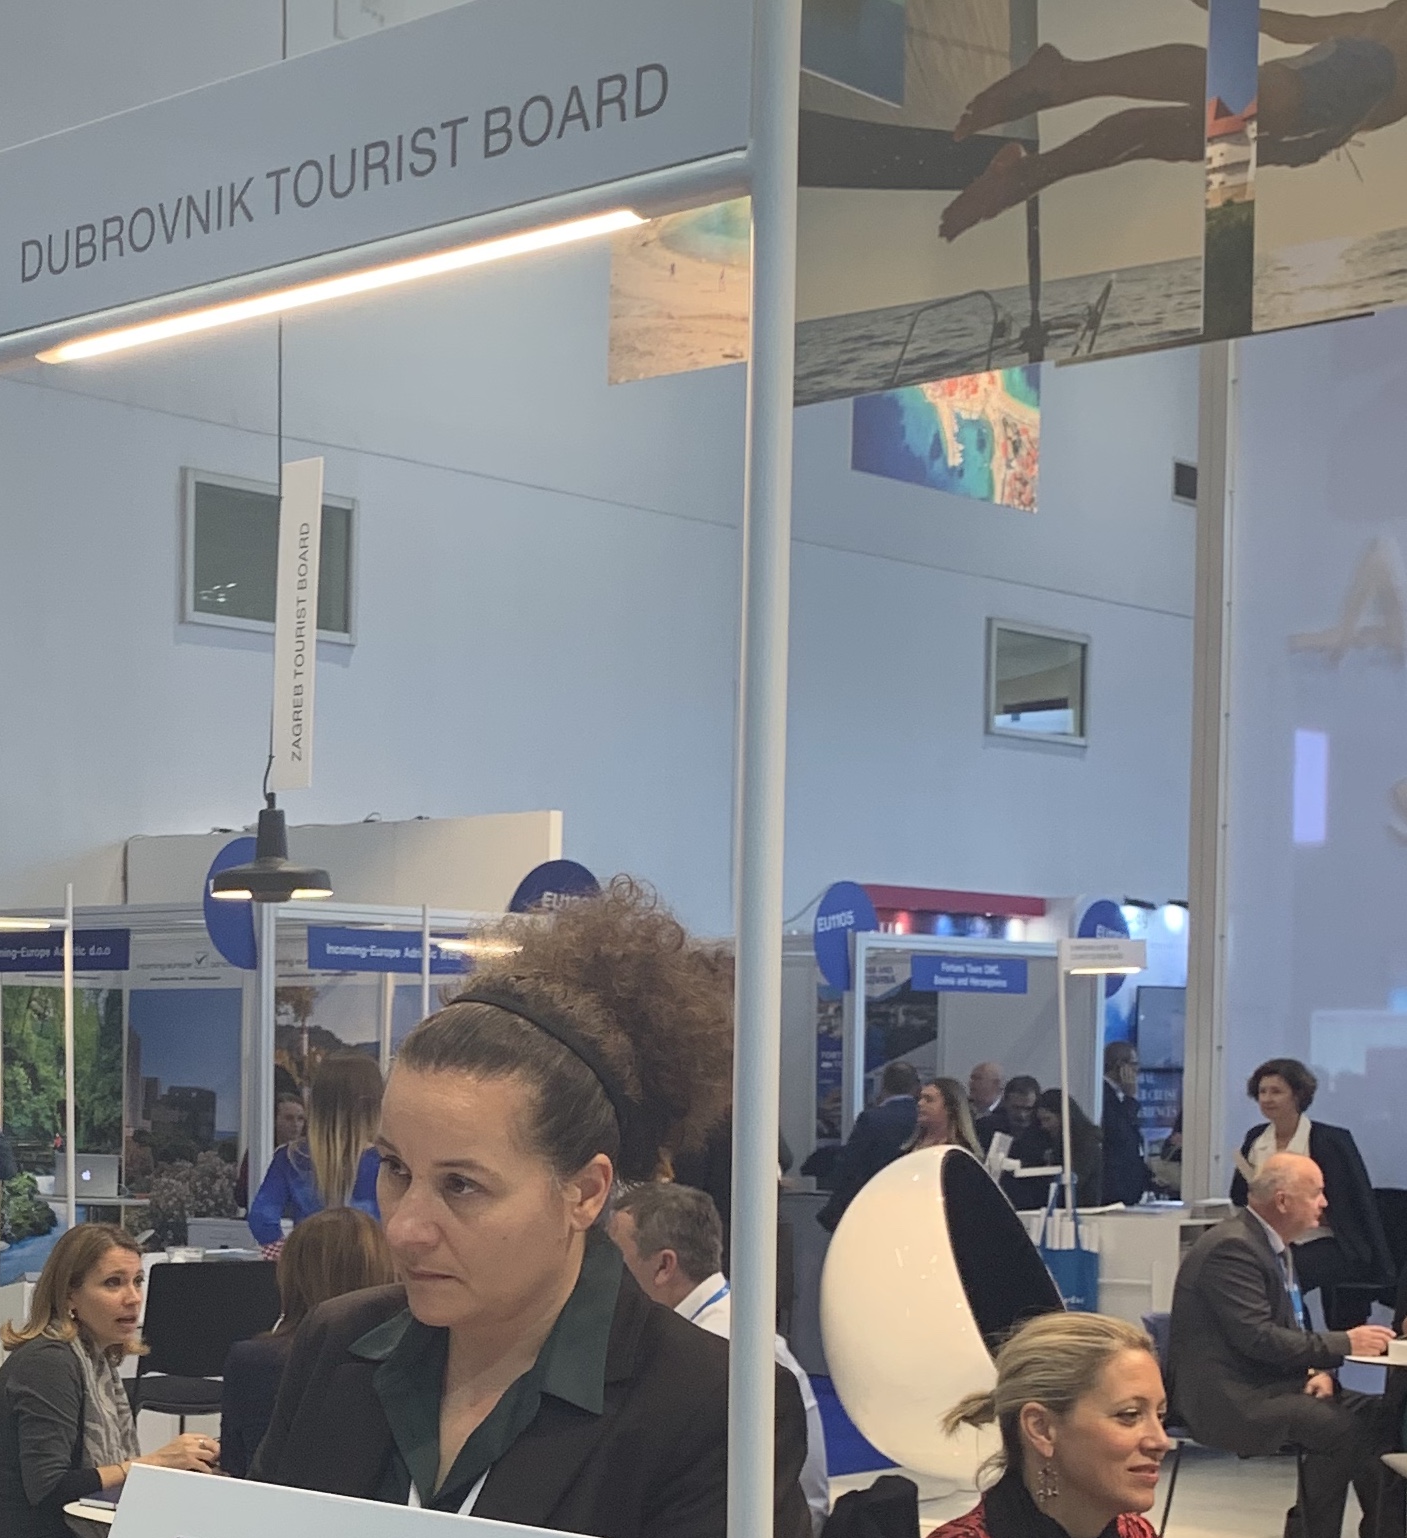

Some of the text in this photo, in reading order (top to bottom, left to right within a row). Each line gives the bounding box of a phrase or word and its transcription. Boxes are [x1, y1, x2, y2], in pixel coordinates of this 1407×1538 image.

[21, 62, 670, 284] DUBROVNIK TOURIST BOARD
[291, 522, 311, 763] ZAGREB TOURIST BOARD
